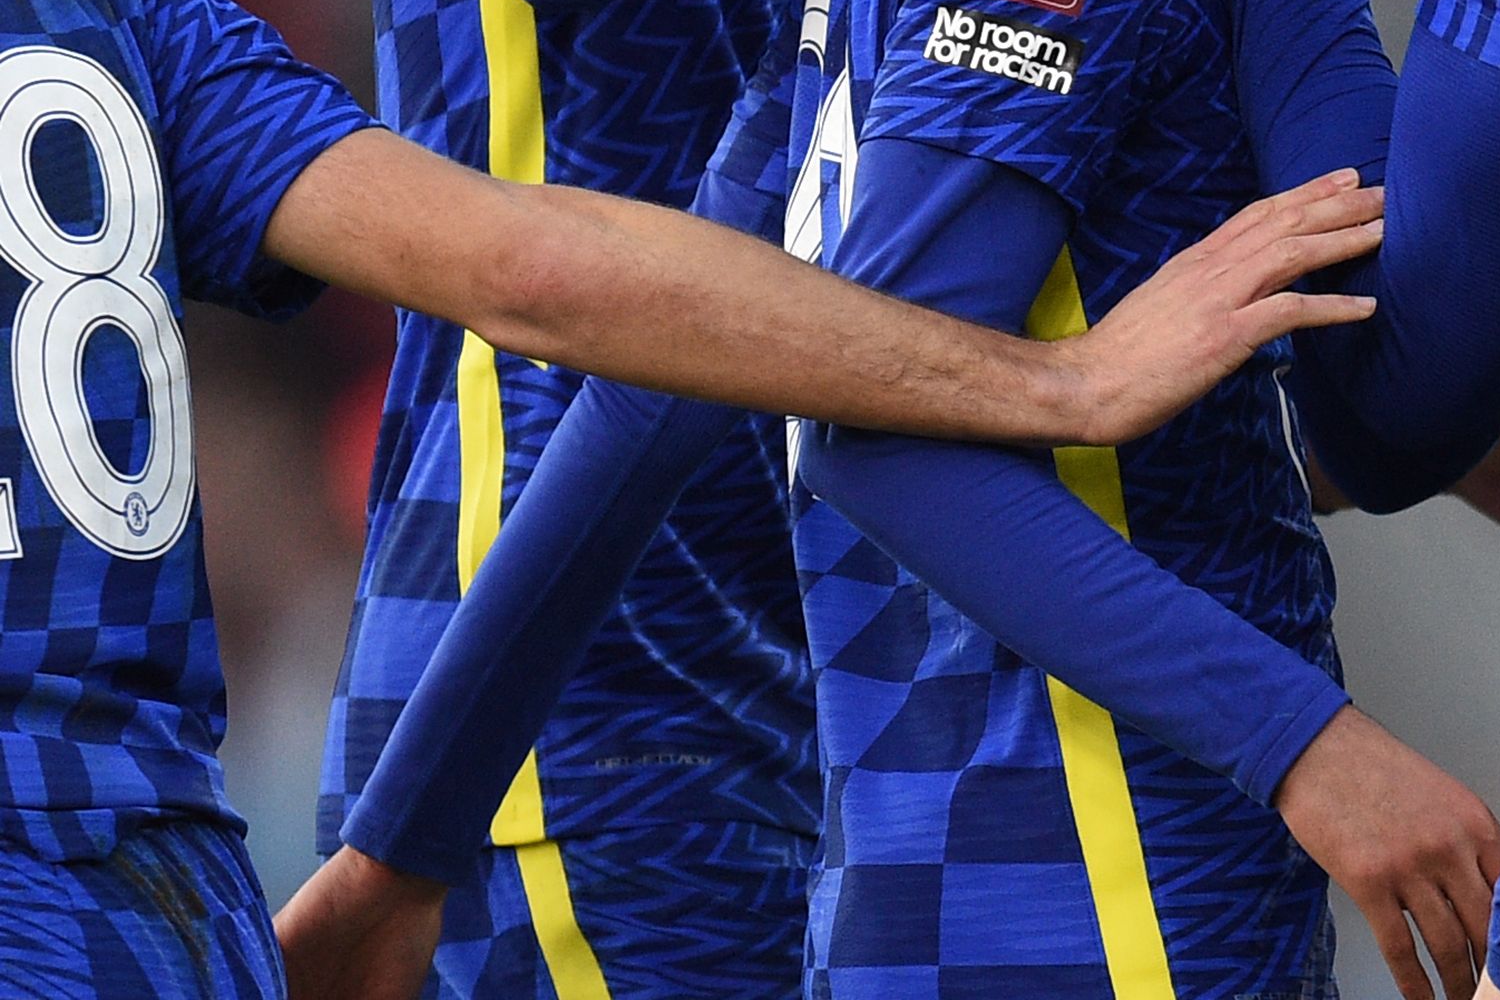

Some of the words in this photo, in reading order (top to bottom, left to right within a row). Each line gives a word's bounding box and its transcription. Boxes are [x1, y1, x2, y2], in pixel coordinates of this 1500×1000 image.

[923, 31, 971, 65] for
[969, 46, 1073, 95] racism
[932, 6, 976, 41] No
[979, 21, 1067, 66] room
[0, 45, 197, 561] 8
